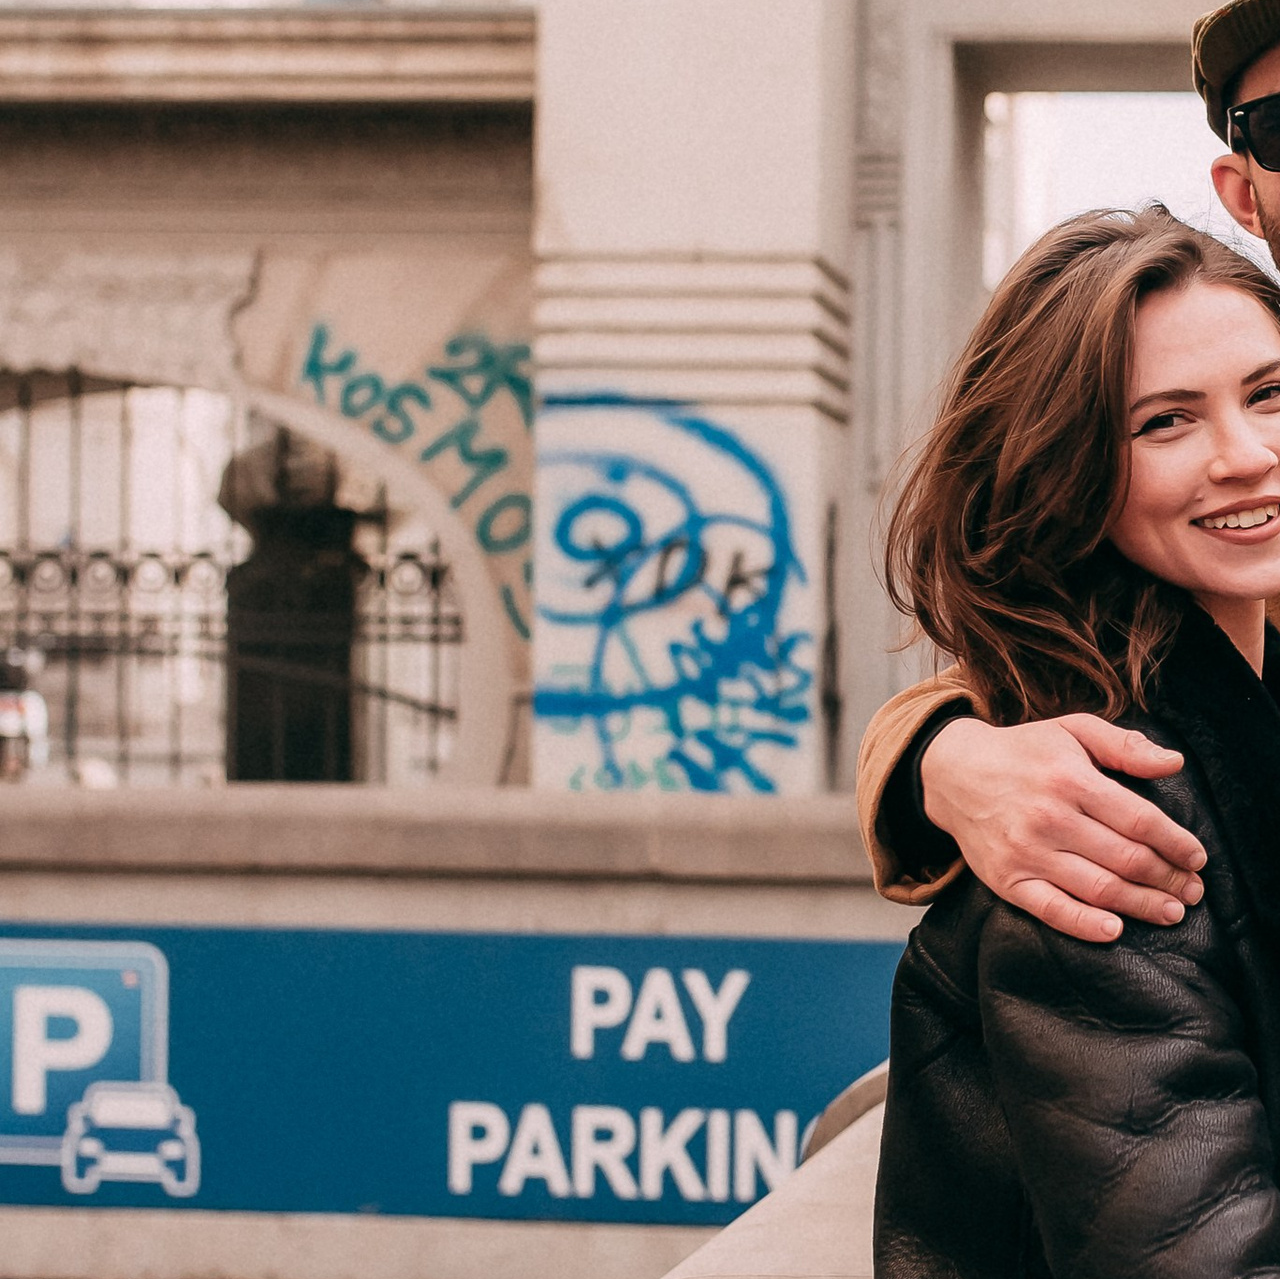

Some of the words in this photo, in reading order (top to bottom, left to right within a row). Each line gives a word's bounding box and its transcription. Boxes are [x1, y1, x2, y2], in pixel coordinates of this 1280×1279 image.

[303, 324, 532, 638] KOSMO
[12, 984, 114, 1116] P
[570, 964, 751, 1063] PAY
[447, 1100, 818, 1202] PARKIN
